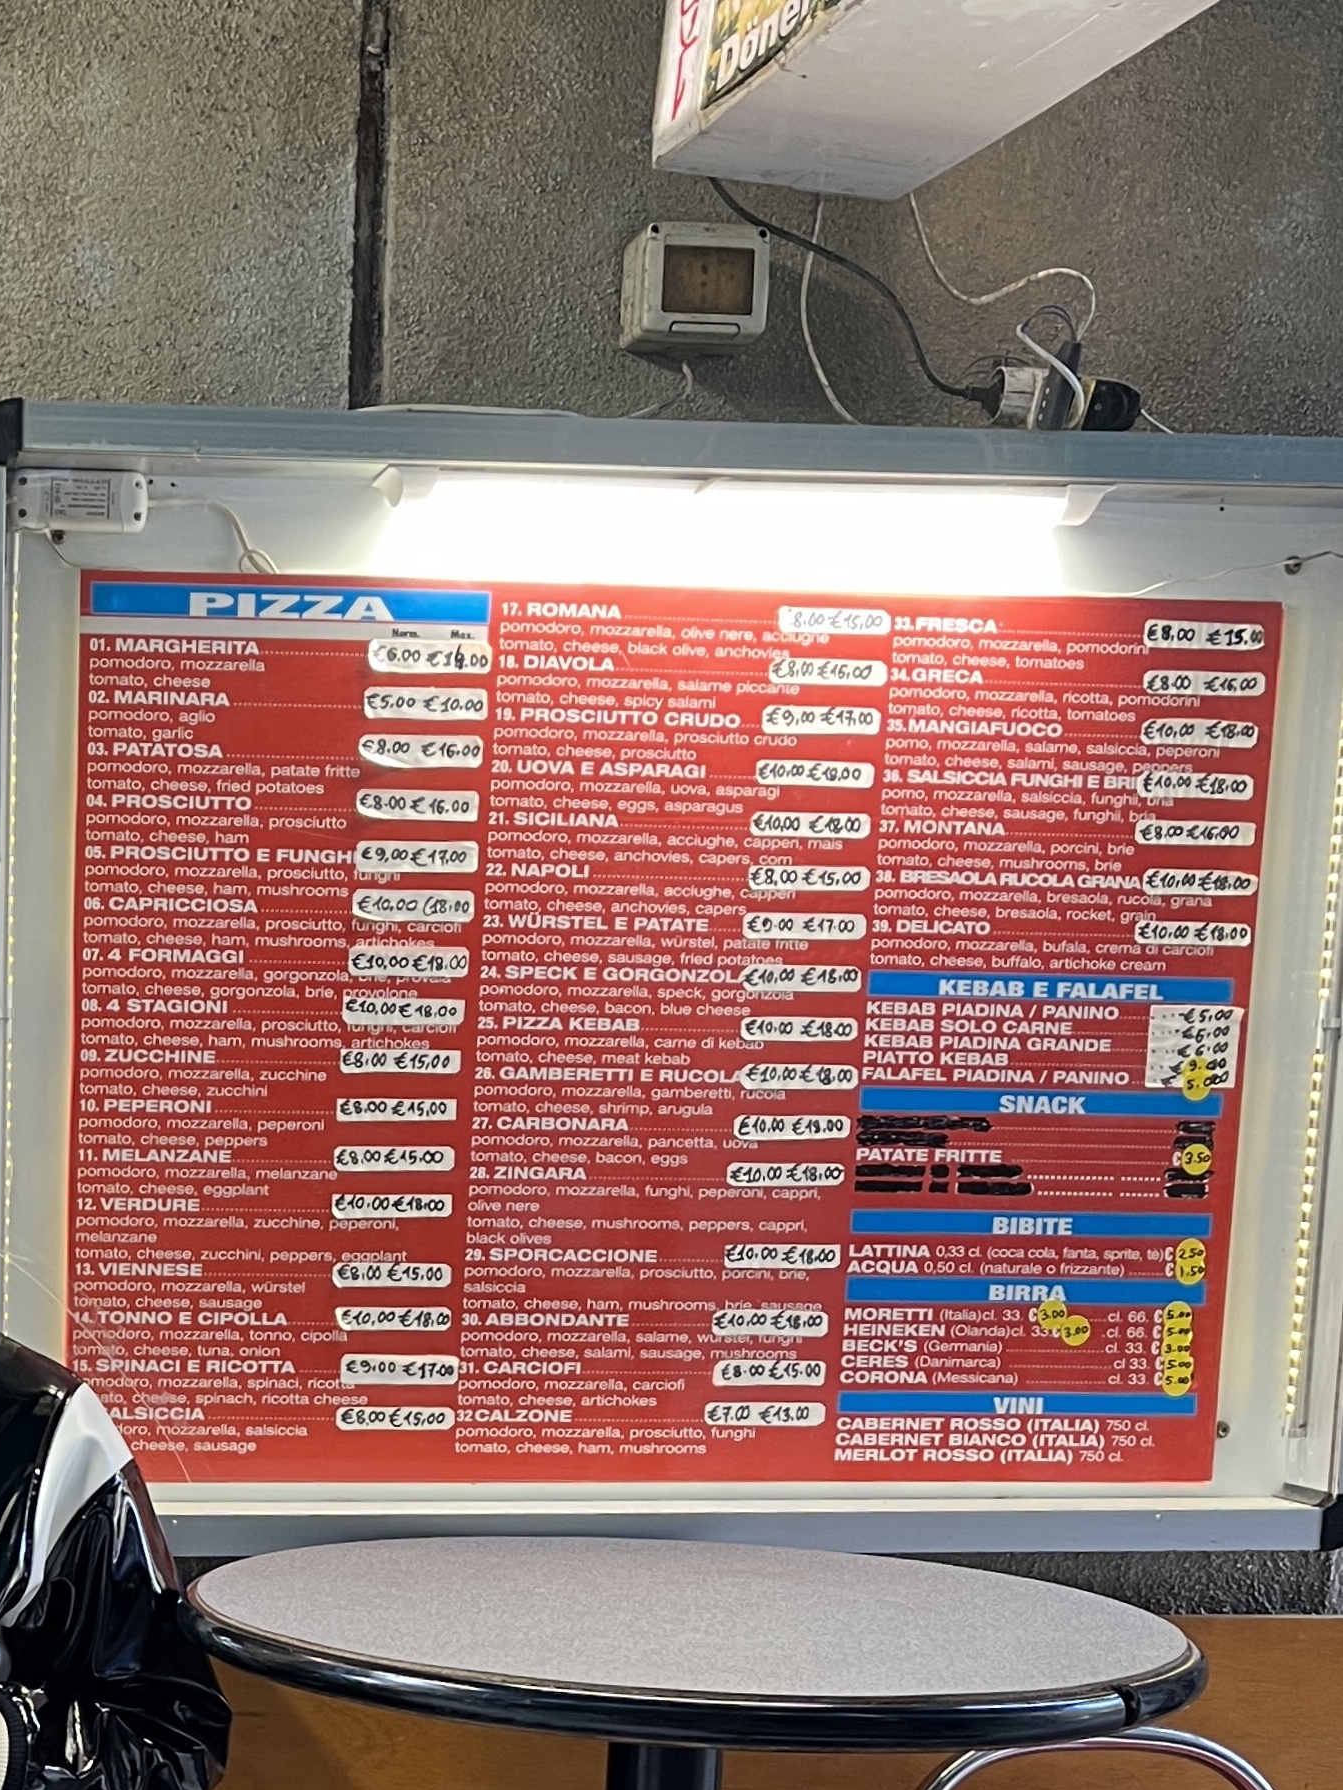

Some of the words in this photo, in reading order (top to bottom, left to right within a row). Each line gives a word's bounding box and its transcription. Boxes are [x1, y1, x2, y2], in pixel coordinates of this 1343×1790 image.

[189, 591, 395, 621] PIZZA
[501, 602, 522, 616] 17.
[527, 602, 621, 619] ROMANA
[90, 638, 111, 651] 01.
[115, 638, 259, 655] MARGHERITA
[89, 656, 175, 671] pomodoro,
[180, 659, 265, 672] mozzarella
[892, 651, 947, 666] tomato,
[952, 653, 1010, 669] cheese,
[1015, 655, 1084, 670] tomatoes
[89, 673, 148, 688] tomato,
[153, 674, 211, 688] cheese
[88, 690, 109, 703] 02.
[114, 690, 230, 706] MARINARA
[88, 708, 173, 723] pomodoro,
[179, 710, 215, 725] aglio
[495, 707, 516, 721] 19.
[520, 707, 658, 726] PROSCIUTTO
[664, 712, 741, 728] CRUDO
[87, 725, 146, 740] tomato,
[152, 727, 194, 742] garlic
[87, 742, 108, 756] 03.
[113, 742, 223, 758] PATATOSA
[492, 742, 551, 757] tomato,
[556, 744, 615, 760] cheese,
[621, 742, 696, 763] prosciutto
[879, 819, 899, 833] 37.
[904, 819, 1006, 836] MONTANA
[483, 914, 504, 928] 23.
[508, 909, 608, 930] WÜRSTEL
[614, 917, 628, 930] E
[634, 917, 709, 932] PATATE
[872, 919, 892, 933] 39.
[896, 919, 991, 935] DELICATO
[939, 979, 1025, 997] KEBAB
[1033, 981, 1049, 998] E
[1056, 982, 1164, 1000] FALAFEL
[81, 998, 102, 1012] 08.
[106, 999, 120, 1012] 4
[127, 998, 227, 1014] STAGIONI
[865, 1018, 934, 1032] KEBAB
[940, 1019, 997, 1034] SOLO
[1002, 1020, 1073, 1035] CARNE
[80, 1049, 101, 1062] 09.
[104, 1049, 216, 1064] ZUCCHINE
[863, 1050, 934, 1065] PIATTO
[940, 1052, 1008, 1066] KEBAB
[80, 1066, 162, 1080] pomodoro,
[168, 1068, 254, 1082] mozzarella,
[259, 1069, 327, 1082] zucchine
[79, 1082, 137, 1096] tomato,
[142, 1083, 201, 1097] cheese,
[206, 1084, 268, 1097] zucchini
[999, 1095, 1086, 1115] SNACK
[78, 1148, 98, 1162] 11.
[102, 1148, 232, 1163] MELANZANE
[77, 1182, 133, 1195] tomato,
[138, 1182, 198, 1196] cheese,
[203, 1183, 270, 1198] eggplant
[992, 1217, 1073, 1235] BIBITE
[847, 1260, 918, 1275] ACQUA
[924, 1261, 955, 1275] 0,50
[958, 1261, 974, 1273] cl.
[980, 1262, 1042, 1276] (naturale
[1046, 1265, 1056, 1274] o
[1060, 1262, 1125, 1278] frizzante)
[989, 1284, 1066, 1303] BIRRA
[97, 1311, 173, 1325] TONNO
[179, 1312, 192, 1325] E
[197, 1312, 288, 1326] CIPOLLA
[133, 1344, 192, 1357] cheese,
[197, 1345, 234, 1357] tuna,
[239, 1345, 280, 1357] onion
[459, 1361, 479, 1374] 31.
[483, 1361, 581, 1375] CARCIOFI
[840, 1370, 928, 1384] CORONA
[932, 1371, 1018, 1386] (Messicana)
[457, 1394, 513, 1407] tomato,
[518, 1394, 576, 1407] cheese,
[581, 1394, 657, 1406] artichokes
[993, 1397, 1044, 1415] VINI
[837, 1418, 942, 1431] CABERNET
[950, 1418, 1021, 1431] ROSSO
[1027, 1418, 1099, 1434] (ITALIA)
[1106, 1419, 1131, 1431] 750
[1134, 1420, 1149, 1432] cl.
